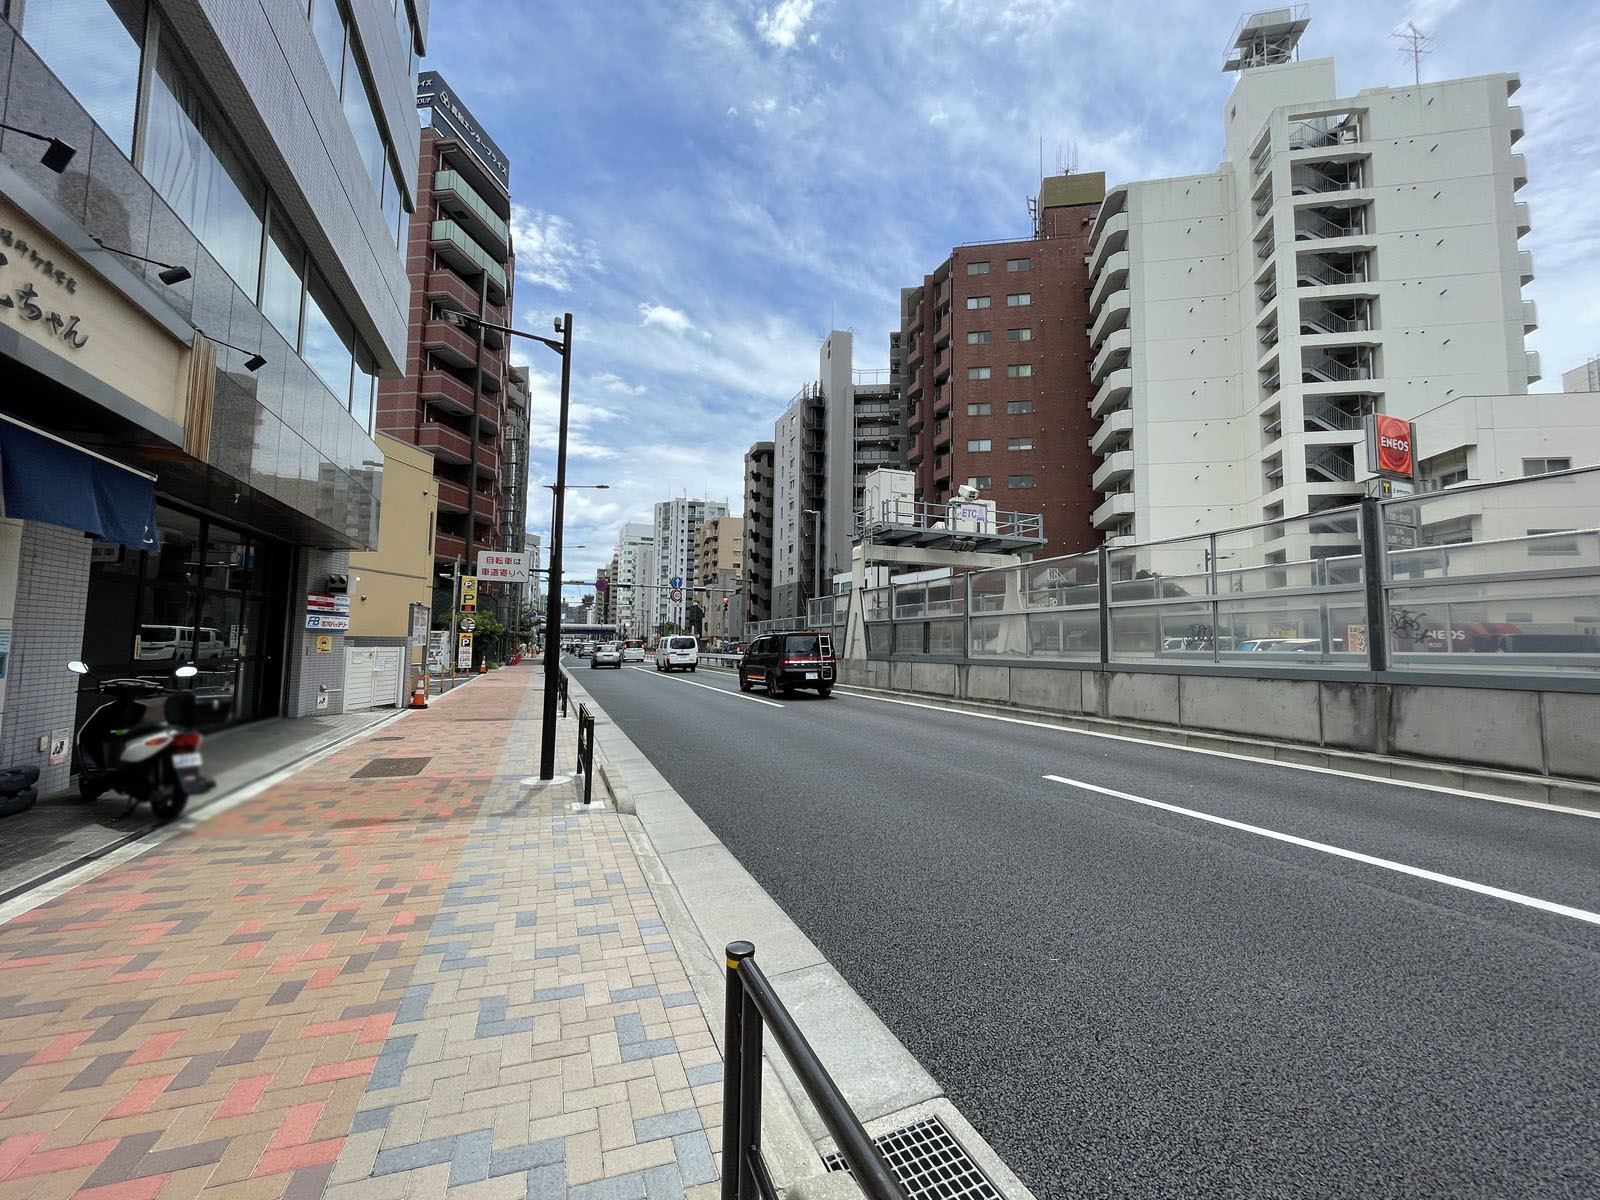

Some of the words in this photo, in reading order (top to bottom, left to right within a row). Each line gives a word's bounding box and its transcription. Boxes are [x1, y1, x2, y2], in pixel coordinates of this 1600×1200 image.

[1380, 436, 1409, 452] ENEOS
[962, 508, 977, 518] ETC
[486, 556, 521, 565] 自転車は
[481, 568, 525, 577] 車道寄りへ
[463, 594, 474, 603] P
[462, 639, 470, 647] P
